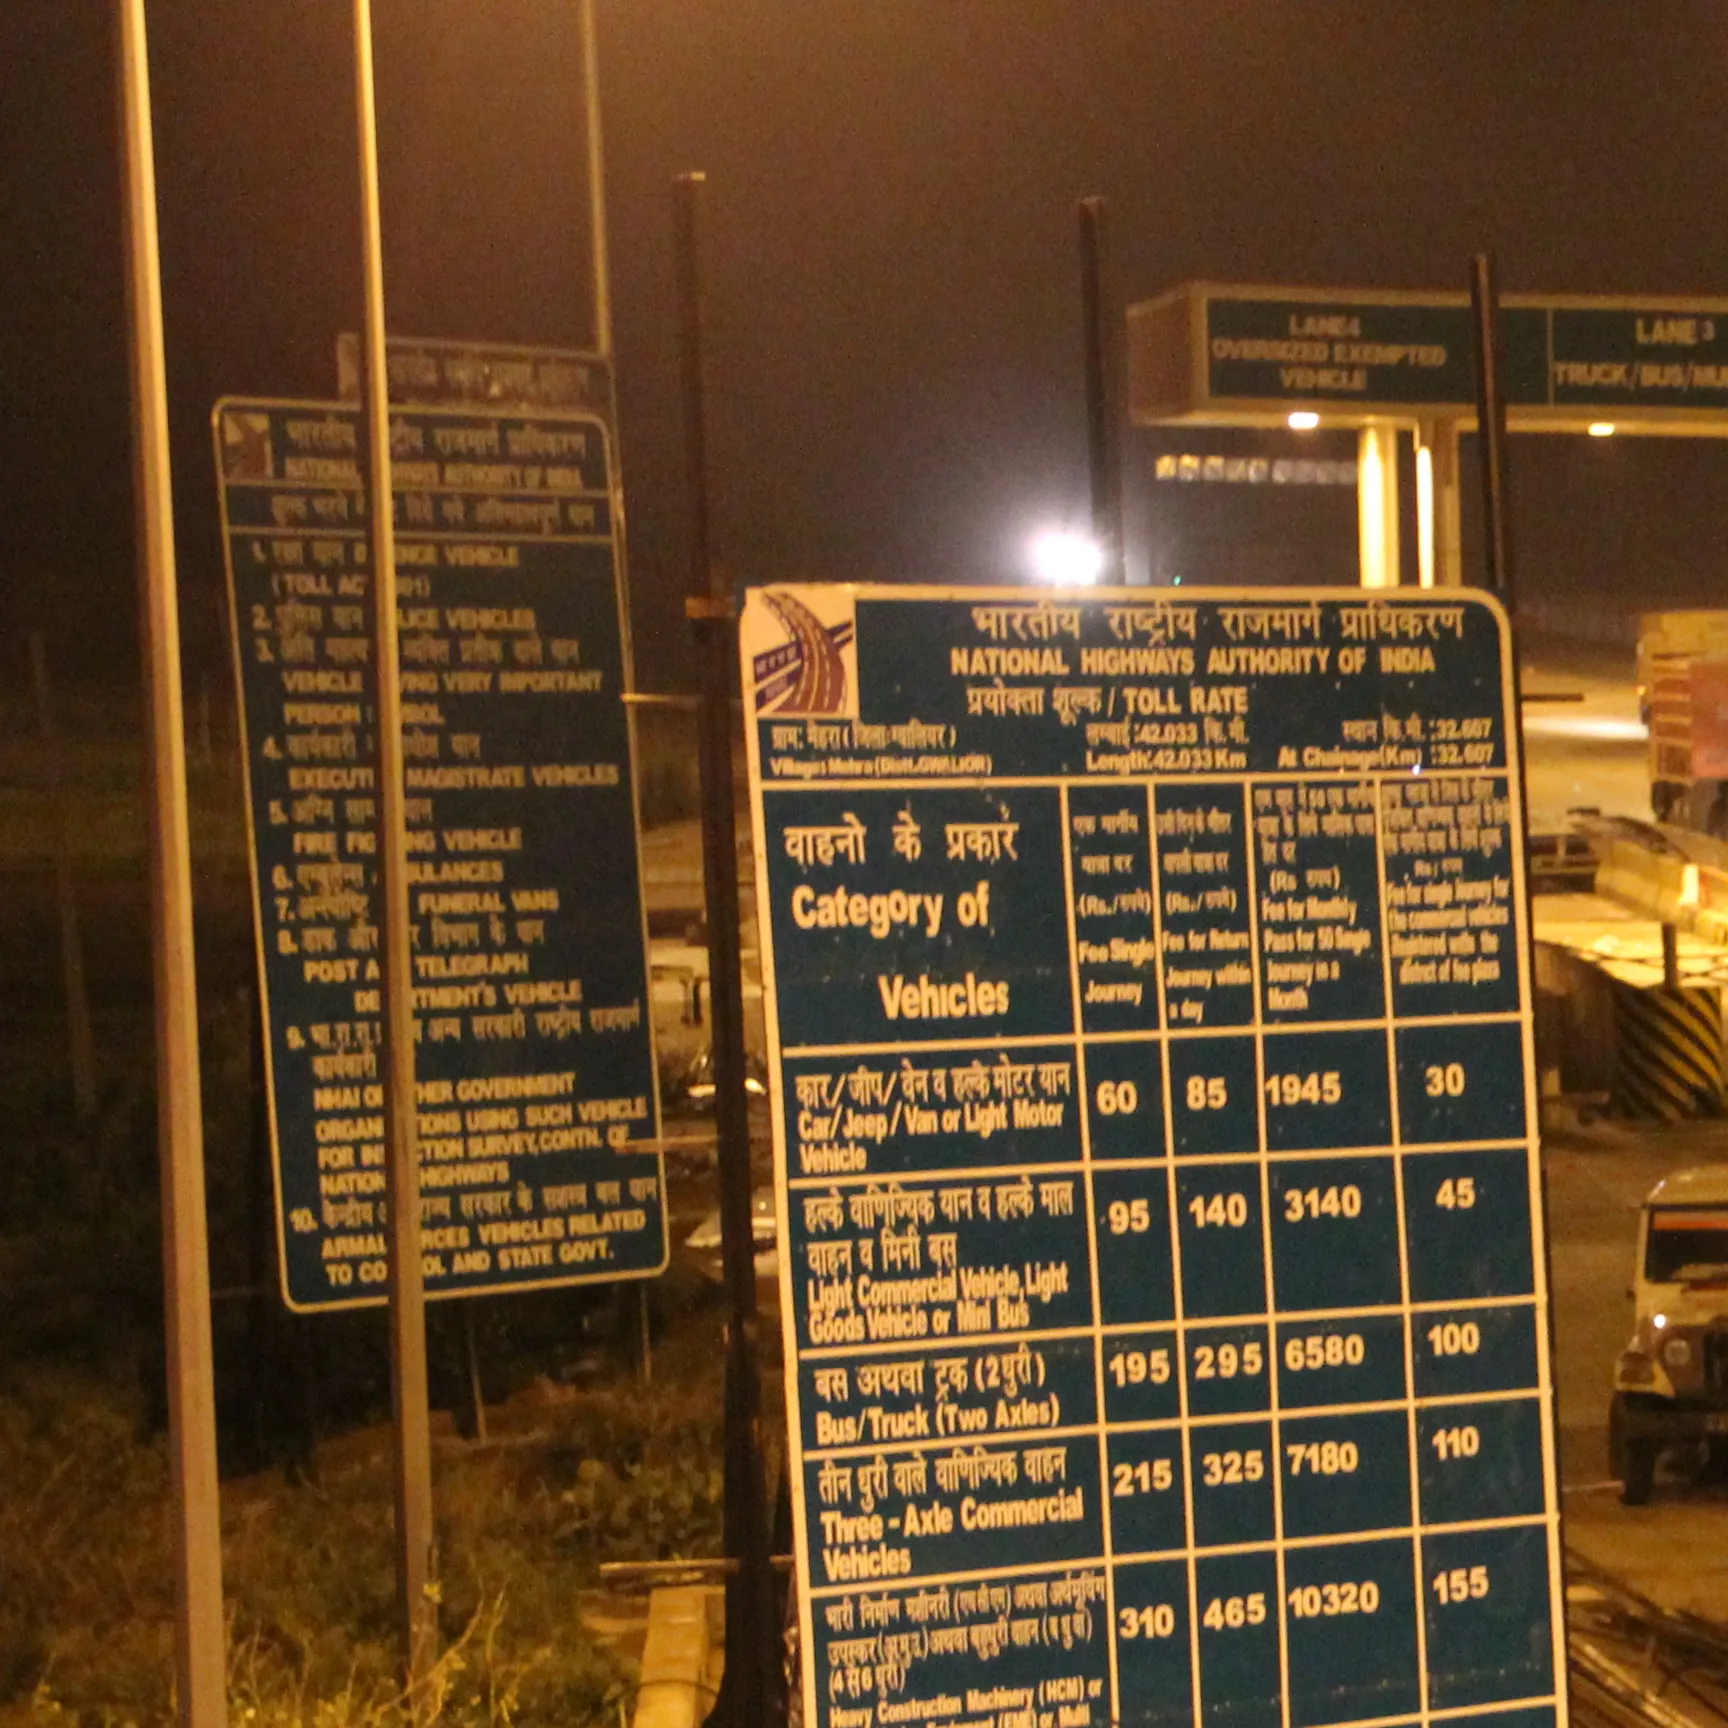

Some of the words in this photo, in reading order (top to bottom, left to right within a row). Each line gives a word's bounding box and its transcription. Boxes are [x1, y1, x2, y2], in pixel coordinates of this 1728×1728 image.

[1636, 318, 1696, 345] LANE
[971, 603, 1082, 641] भारतीय
[1104, 601, 1198, 646] राष्ट्रीय
[1217, 601, 1322, 641] राजमार्ग
[1339, 601, 1465, 641] प्राधिकरण
[951, 648, 1069, 675] NATIONAL
[1081, 647, 1195, 675] HIGHWAYS
[1207, 647, 1330, 674] AUTHORITY
[1338, 647, 1366, 674] OF
[1380, 647, 1436, 674] INDIA
[1122, 687, 1182, 714] TOLL
[1190, 685, 1248, 714] RATE
[892, 810, 921, 862] के
[791, 884, 943, 939] Category
[957, 880, 990, 927] of
[878, 972, 1010, 1020] Vehicles
[1096, 1080, 1138, 1115] 60
[1186, 1076, 1227, 1111] 85
[1264, 1072, 1342, 1106] 1945
[1425, 1063, 1465, 1097] 30
[964, 1101, 1008, 1140] Light
[1013, 1098, 1064, 1129] Motor
[800, 1140, 867, 1174] Vehicle
[1108, 1200, 1150, 1235] 95
[1189, 1193, 1248, 1228] 140
[1285, 1185, 1362, 1222] 3140
[1435, 1177, 1476, 1210] 45
[857, 1273, 958, 1308] Commercial
[808, 1310, 865, 1345] Goods
[866, 1306, 928, 1339] Vehicle
[956, 1300, 992, 1333] Mini
[997, 1297, 1031, 1329] Bus
[1109, 1348, 1171, 1388] 195
[1194, 1342, 1263, 1379] 295
[1284, 1334, 1364, 1371] 6580
[1428, 1322, 1481, 1357] 100
[935, 1401, 989, 1437] (Two
[995, 1393, 1061, 1429] Axles)
[1112, 1459, 1173, 1497] 215
[1202, 1450, 1264, 1487] 325
[1287, 1441, 1359, 1476] 7180
[1432, 1425, 1480, 1461] 110
[820, 1510, 884, 1546] Three
[903, 1501, 953, 1537] Axle
[960, 1486, 1085, 1531] Commercial
[822, 1543, 912, 1582] Vehicles
[1119, 1605, 1175, 1639] 310
[1203, 1593, 1266, 1631] 465
[1288, 1581, 1380, 1619] 10320
[1433, 1566, 1489, 1606] 155
